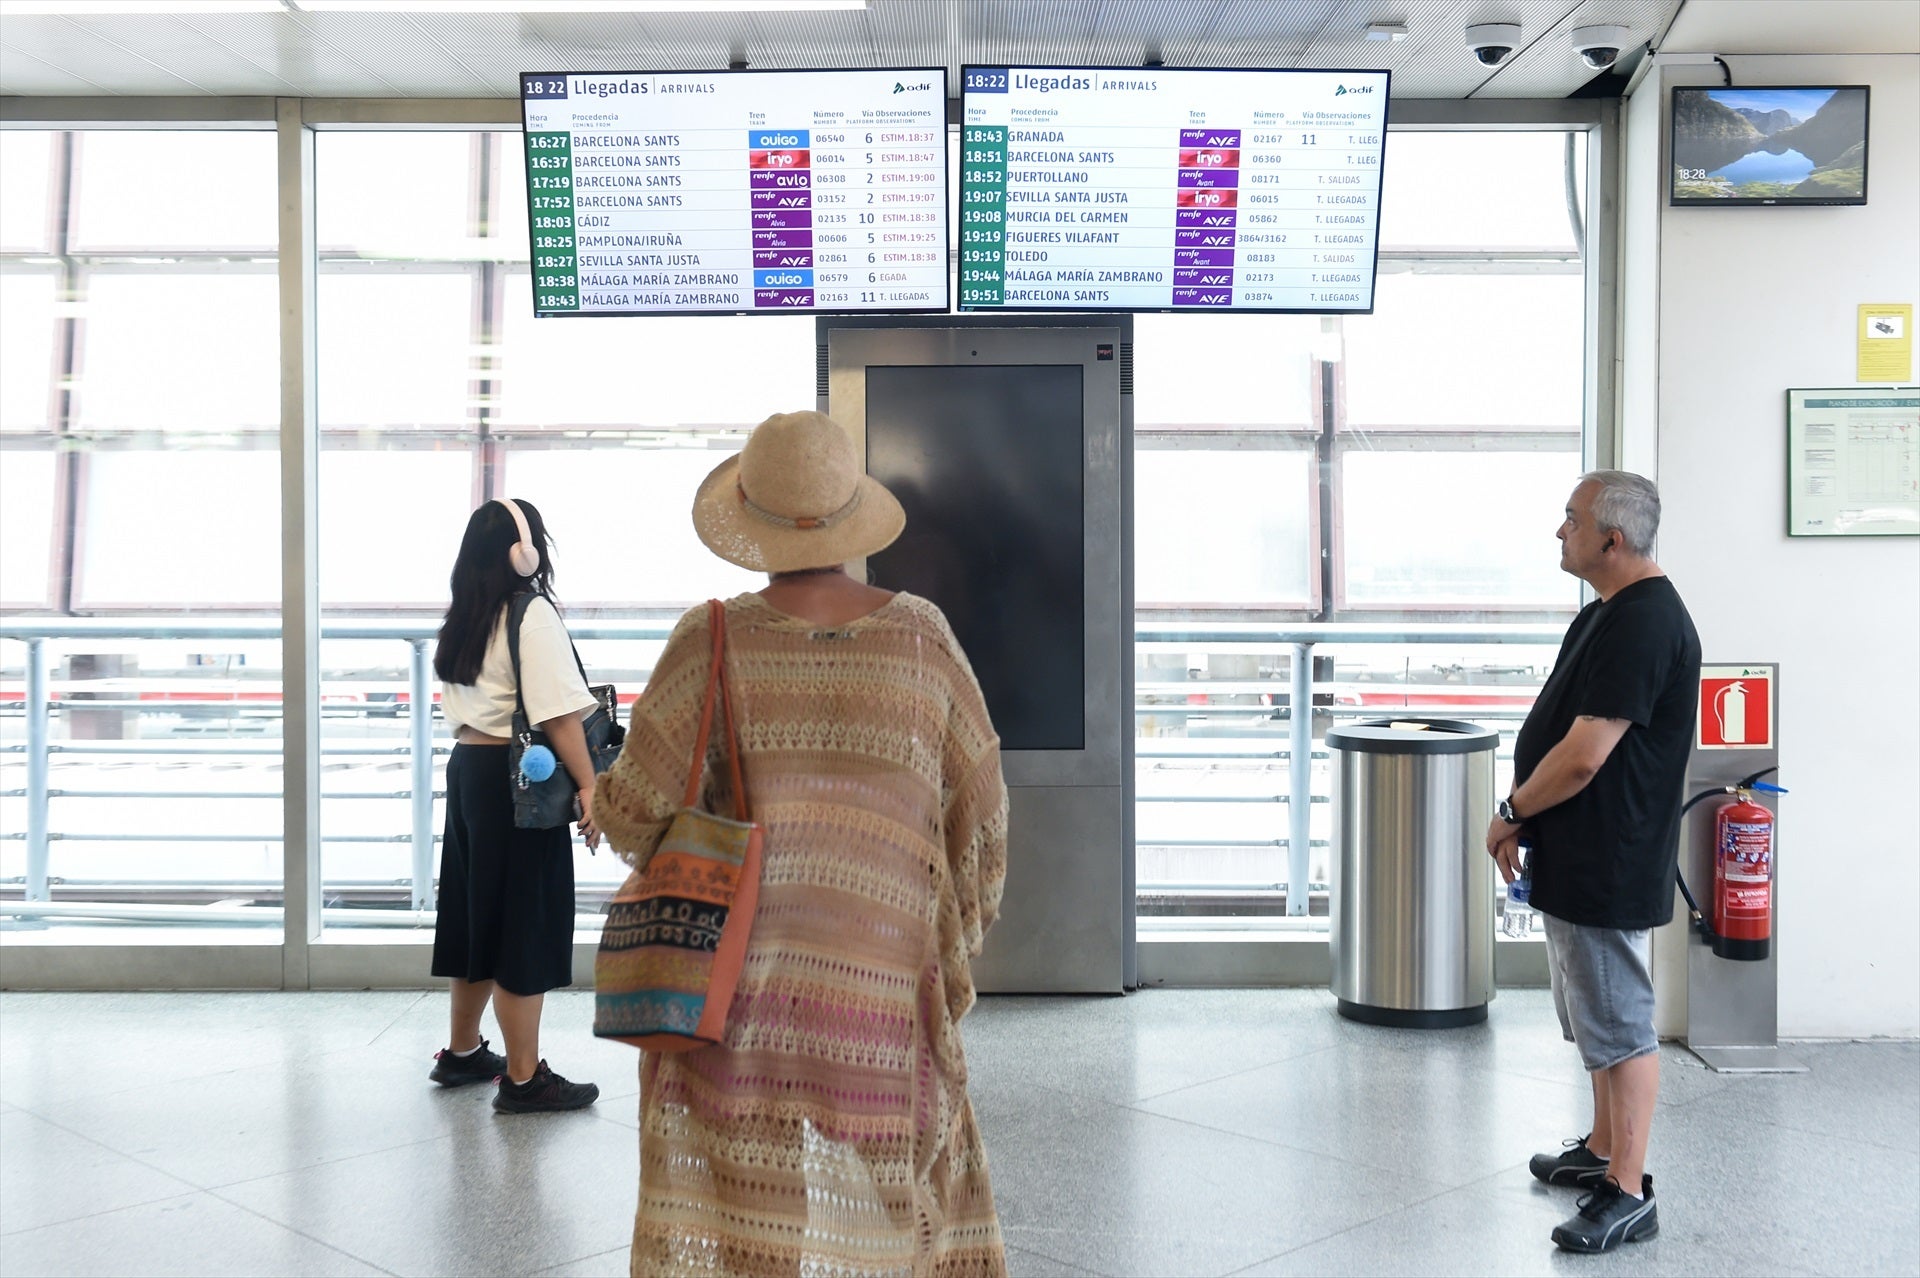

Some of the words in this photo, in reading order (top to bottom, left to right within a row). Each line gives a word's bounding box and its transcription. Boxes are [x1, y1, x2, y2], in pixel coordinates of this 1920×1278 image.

[526, 81, 543, 94] 18
[548, 81, 565, 93] 22
[906, 83, 932, 91] adif
[967, 74, 1006, 87] 18:22
[1015, 74, 1090, 93] Llegadas
[1102, 81, 1157, 90] ARRIVALS
[574, 79, 648, 98] Llegadas
[661, 84, 715, 93] ARRIVALS
[1349, 85, 1374, 94] adif
[529, 114, 548, 122] Hora
[572, 113, 619, 121] Procedencia
[749, 111, 766, 119] Tren
[876, 109, 931, 117] Observaciones
[968, 107, 986, 115] Hora
[1011, 108, 1058, 116] Procedencia
[1189, 110, 1206, 118] Tren
[1316, 111, 1371, 119] Observaciones
[530, 136, 567, 148] 16:27
[573, 137, 640, 147] BARCELONA
[644, 135, 680, 146] SANTS
[815, 134, 845, 142] 06540
[865, 132, 873, 143] 6
[881, 133, 934, 142] ESTIM.18:37
[966, 130, 1003, 143] 18:43
[1008, 131, 1064, 142] GRANADA
[1183, 130, 1205, 139] renfe
[1207, 136, 1238, 147] AVE
[1253, 135, 1282, 143] 02167
[1301, 134, 1317, 145] 11
[531, 157, 568, 168] 16:37
[575, 157, 641, 167] BARCELONA
[645, 155, 681, 166] SANTS
[767, 152, 793, 167] iryo
[816, 154, 845, 163] 06014
[866, 153, 873, 163] 5
[882, 153, 934, 162] ESTIM.18:47
[966, 151, 1002, 163] 18:51
[1007, 151, 1075, 162] BARCELONA
[1079, 152, 1114, 163] SANTS
[1196, 151, 1222, 166] iryo
[1252, 155, 1281, 163] 06360
[1357, 156, 1376, 164] LLEG
[533, 177, 570, 188] 17:19
[575, 177, 642, 187] BARCELONA
[646, 175, 681, 186] SANTS
[753, 171, 775, 180] renfe
[776, 173, 808, 188] avlo
[817, 174, 846, 183] 06308
[866, 173, 873, 183] 2
[882, 173, 935, 182] ESTIM.19:00
[965, 171, 1002, 183] 18:52
[1007, 172, 1089, 183] PUERTOLLANO
[1181, 170, 1203, 179] renfe
[1251, 175, 1280, 183] 08171
[1329, 176, 1361, 184] SALIDAS
[1679, 168, 1706, 180] 18:28
[534, 197, 571, 208] 17:52
[577, 197, 643, 207] BARCELONA
[647, 195, 682, 206] SANTS
[753, 191, 776, 200] renfe
[778, 197, 808, 207] AVE
[817, 194, 846, 202] 03152
[867, 193, 873, 204] 2
[882, 194, 935, 202] ESTIM.19:07
[965, 191, 1002, 202] 19:07
[1006, 192, 1050, 202] SEVILLA
[1054, 192, 1091, 203] SANTA
[1095, 192, 1128, 203] JUSTA
[1194, 191, 1220, 206] iryo
[1250, 195, 1279, 203] 06015
[1327, 195, 1367, 204] LLEGADAS
[535, 217, 572, 228] 18:03
[577, 214, 610, 227] CÁDIZ
[754, 211, 777, 220] renfe
[818, 214, 847, 222] 02135
[859, 213, 874, 224] 10
[883, 214, 936, 222] ESTIM.18:38
[964, 211, 1002, 223] 19:08
[1006, 212, 1051, 222] MURCIA
[1055, 212, 1076, 222] DEL
[1081, 212, 1128, 223] CARMEN
[1203, 216, 1234, 226] AVE
[1249, 215, 1278, 223] 05862
[536, 236, 573, 248] 18:25
[578, 232, 682, 246] PAMPLONA/IRUÑA
[755, 231, 777, 240] renfe
[818, 234, 847, 242] 00606
[868, 233, 874, 243] 5
[883, 233, 936, 242] ESTIM.19:25
[964, 231, 1001, 243] 19:19
[1006, 232, 1061, 243] FIGUERES
[1065, 232, 1120, 243] VILAFANT
[1202, 236, 1233, 246] AVE
[1324, 235, 1364, 243] LLEGADAS
[537, 256, 574, 268] 18:27
[579, 256, 623, 266] SEVILLA
[627, 255, 663, 266] SANTA
[667, 254, 700, 265] JUSTA
[755, 251, 778, 259] renfe
[780, 256, 810, 266] AVE
[819, 254, 847, 262] 02861
[868, 252, 875, 263] 6
[884, 253, 936, 262] ESTIM.18:38
[964, 250, 1001, 262] 19:19
[1005, 251, 1048, 262] TOLEDO
[1247, 254, 1275, 262] 08183
[1323, 255, 1355, 263] SALIDAS
[538, 276, 575, 287] 18:38
[581, 272, 628, 286] MÁLAGA
[633, 271, 670, 285] MARÍA
[674, 273, 739, 284] ZAMBRANO
[820, 274, 848, 282] 06579
[869, 272, 876, 283] 6
[880, 273, 907, 281] EGADA
[963, 270, 1000, 282] 19:44
[1005, 268, 1052, 281] MÁLAGA
[1057, 268, 1094, 282] MARÍA
[1098, 271, 1163, 282] ZAMBRANO
[1200, 275, 1231, 285] AVE
[1246, 274, 1274, 282] 02173
[1322, 274, 1361, 282] LLEGADAS
[539, 295, 576, 307] 18:43
[582, 291, 629, 305] MÁLAGA
[634, 291, 671, 305] MARÍA
[675, 293, 739, 304] ZAMBRANO
[757, 290, 779, 298] renfe
[781, 295, 812, 306] AVE
[820, 293, 848, 301] 02163
[861, 291, 876, 303] 11
[889, 292, 930, 301] LLEGADAS
[963, 290, 999, 301] 19:51
[1004, 290, 1070, 301] BARCELONA
[1074, 290, 1109, 301] SANTS
[1199, 294, 1230, 304] AVE
[1245, 293, 1273, 301] 03874
